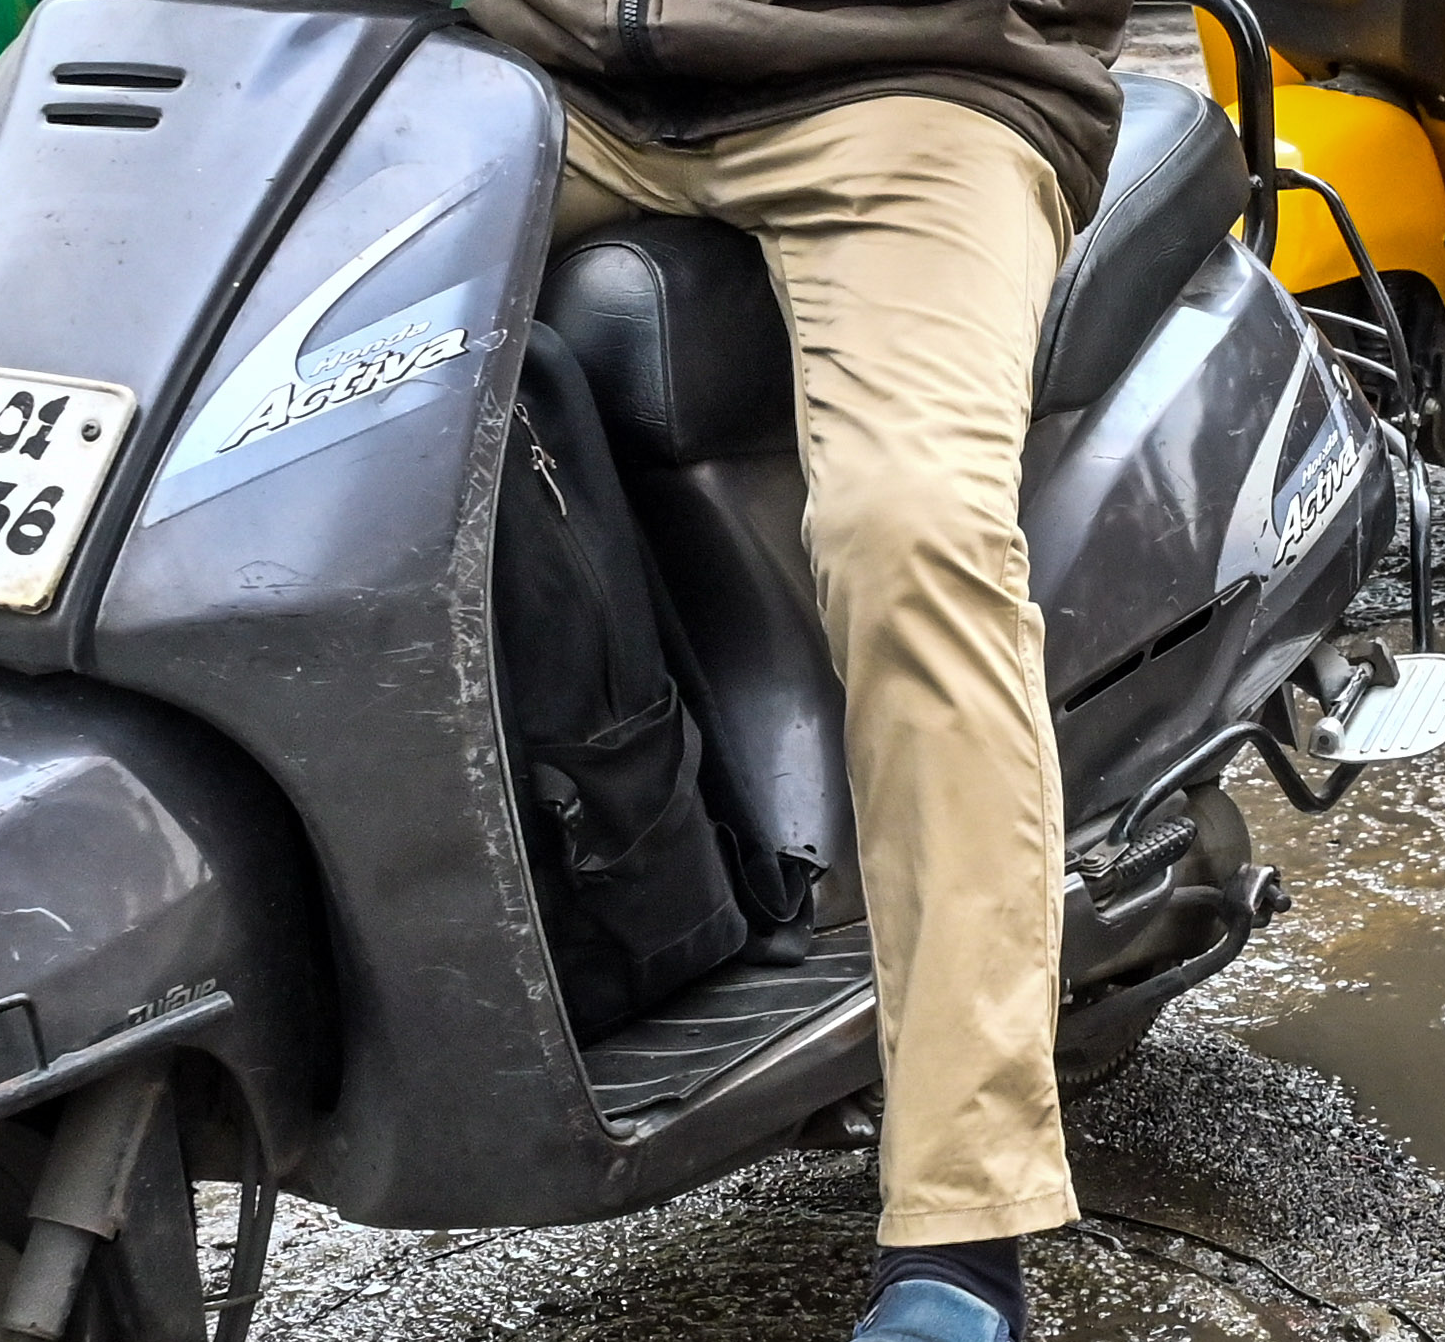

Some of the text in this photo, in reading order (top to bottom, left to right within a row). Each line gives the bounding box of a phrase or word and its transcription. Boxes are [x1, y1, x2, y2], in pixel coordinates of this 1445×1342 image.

[214, 327, 472, 454] Activa
[308, 320, 433, 378] Honda
[1272, 435, 1360, 570] Activa
